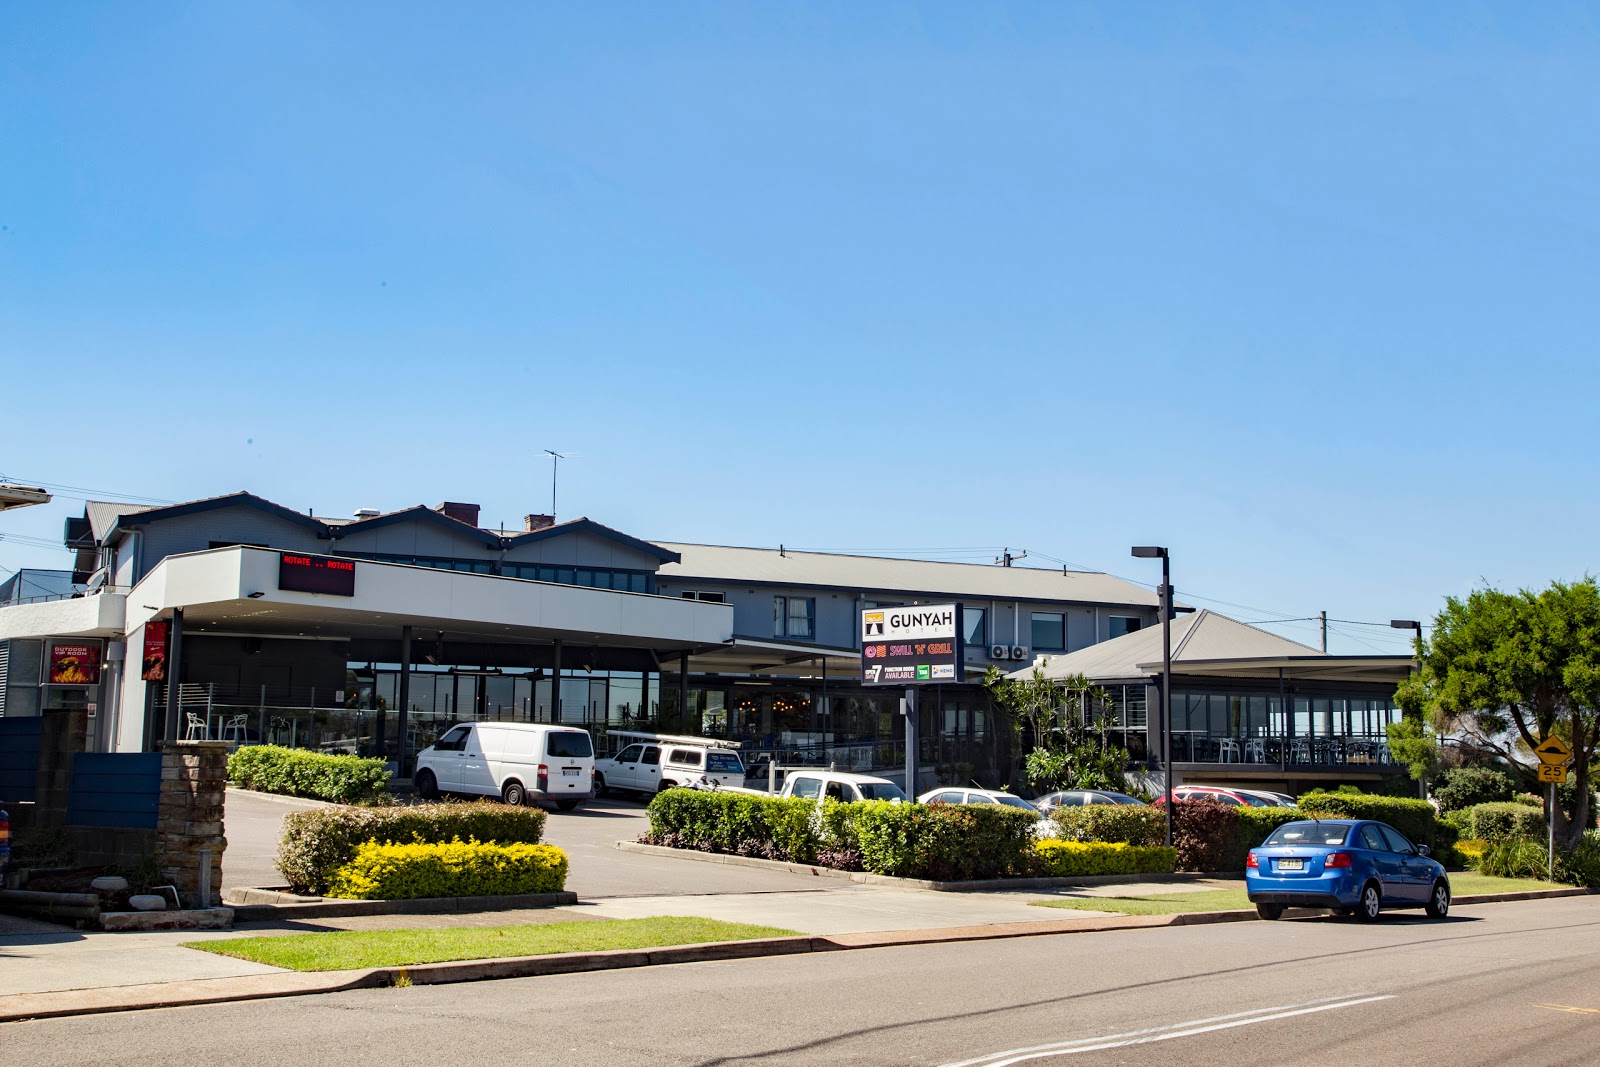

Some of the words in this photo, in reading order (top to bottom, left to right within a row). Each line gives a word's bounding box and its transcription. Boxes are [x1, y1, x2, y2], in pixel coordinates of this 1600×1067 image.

[284, 556, 311, 566] ROTATE
[328, 561, 353, 570] ROTATE
[891, 612, 952, 628] GUNYAH
[889, 645, 913, 657] SWILL
[927, 642, 952, 655] GRILL
[871, 664, 883, 683] 7
[884, 671, 914, 679] AVAILABLE
[1544, 766, 1561, 776] 25
